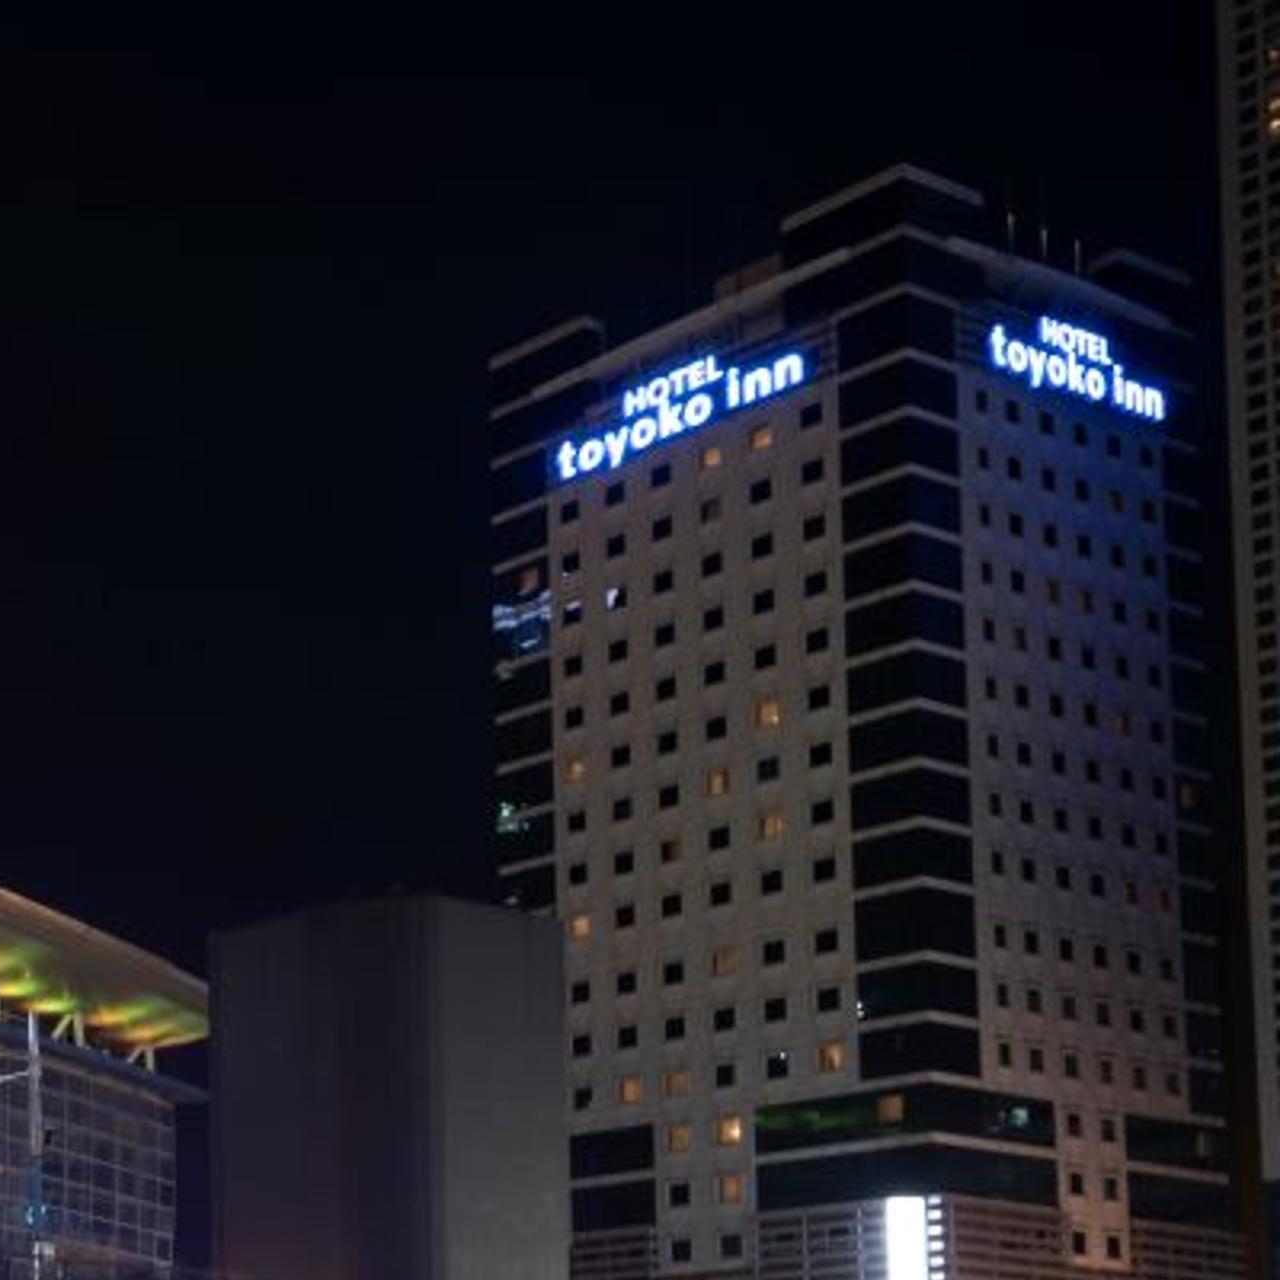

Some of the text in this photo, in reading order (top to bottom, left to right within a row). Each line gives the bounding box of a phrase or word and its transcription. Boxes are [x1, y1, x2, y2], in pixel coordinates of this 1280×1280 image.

[989, 322, 1165, 421] toyoko inn
[1041, 314, 1113, 366] HOTEL
[555, 352, 804, 480] toyoko inn
[623, 354, 724, 417] HOTEL
